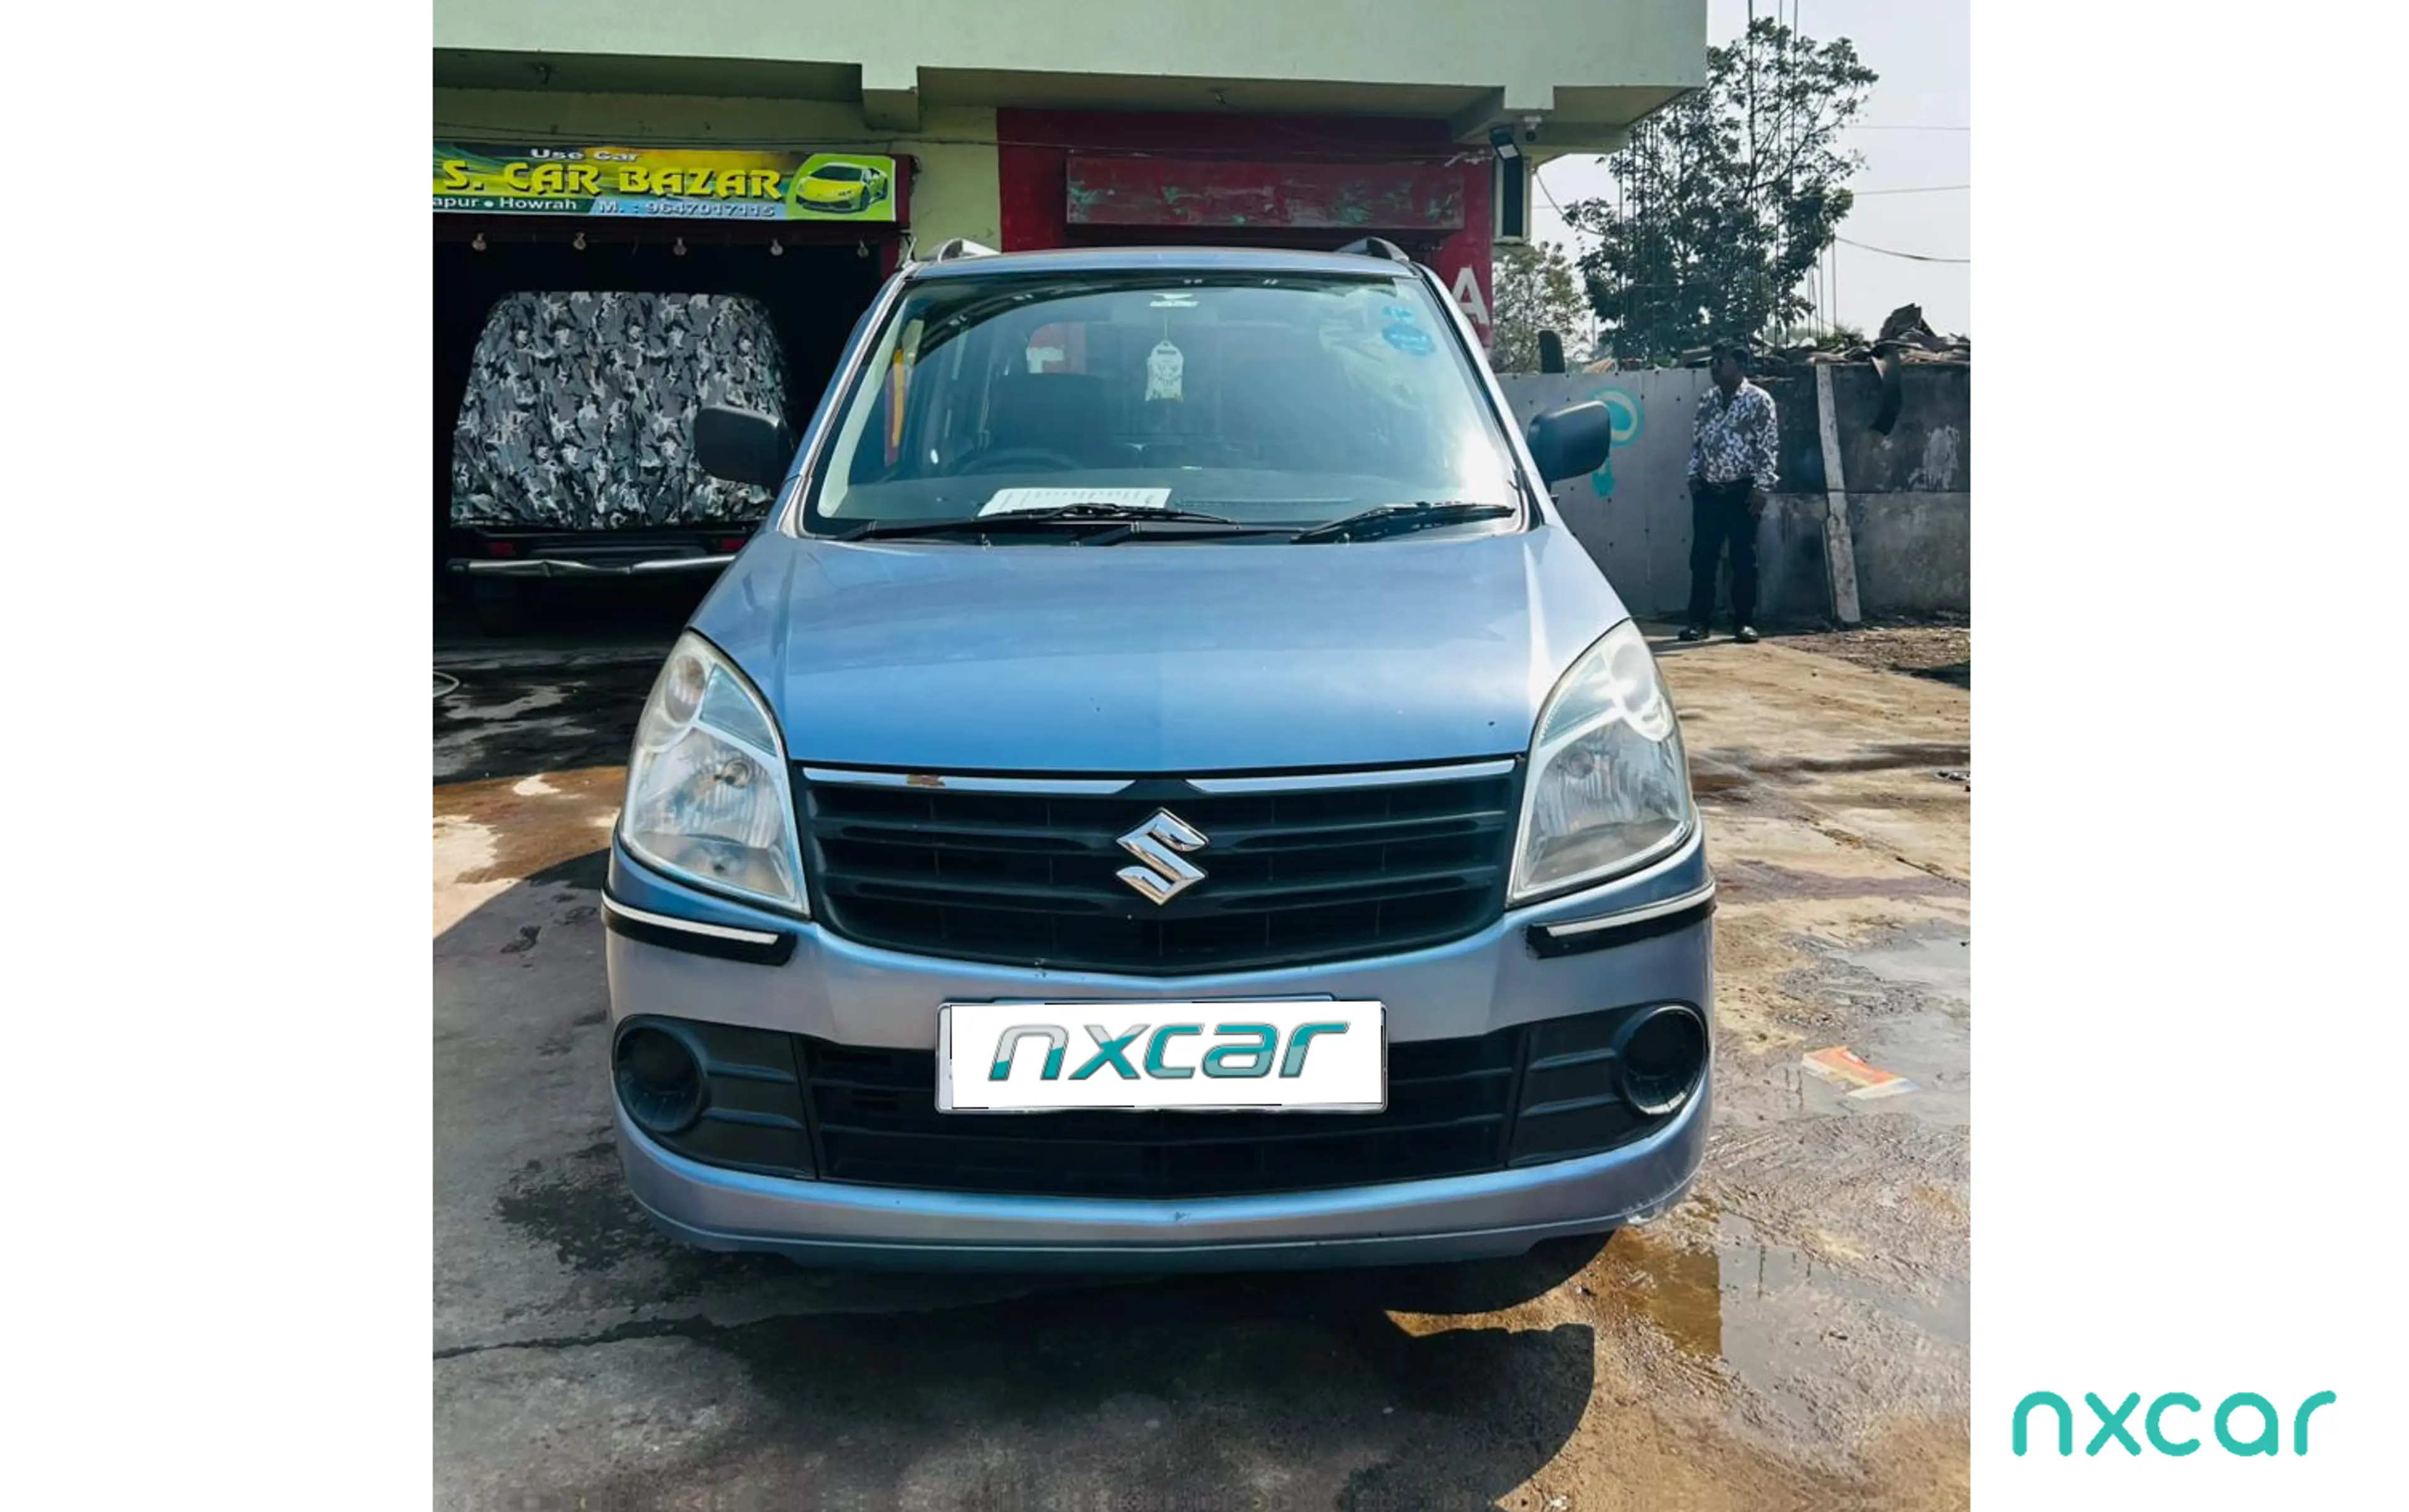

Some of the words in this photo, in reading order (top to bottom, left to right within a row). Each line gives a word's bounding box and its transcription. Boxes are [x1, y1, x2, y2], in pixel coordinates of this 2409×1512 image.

[531, 147, 584, 160] Use
[593, 149, 640, 162] Car
[442, 160, 484, 191] S.
[504, 162, 602, 196] CAR
[619, 166, 783, 201] BAZAR
[500, 196, 577, 211] Howrah
